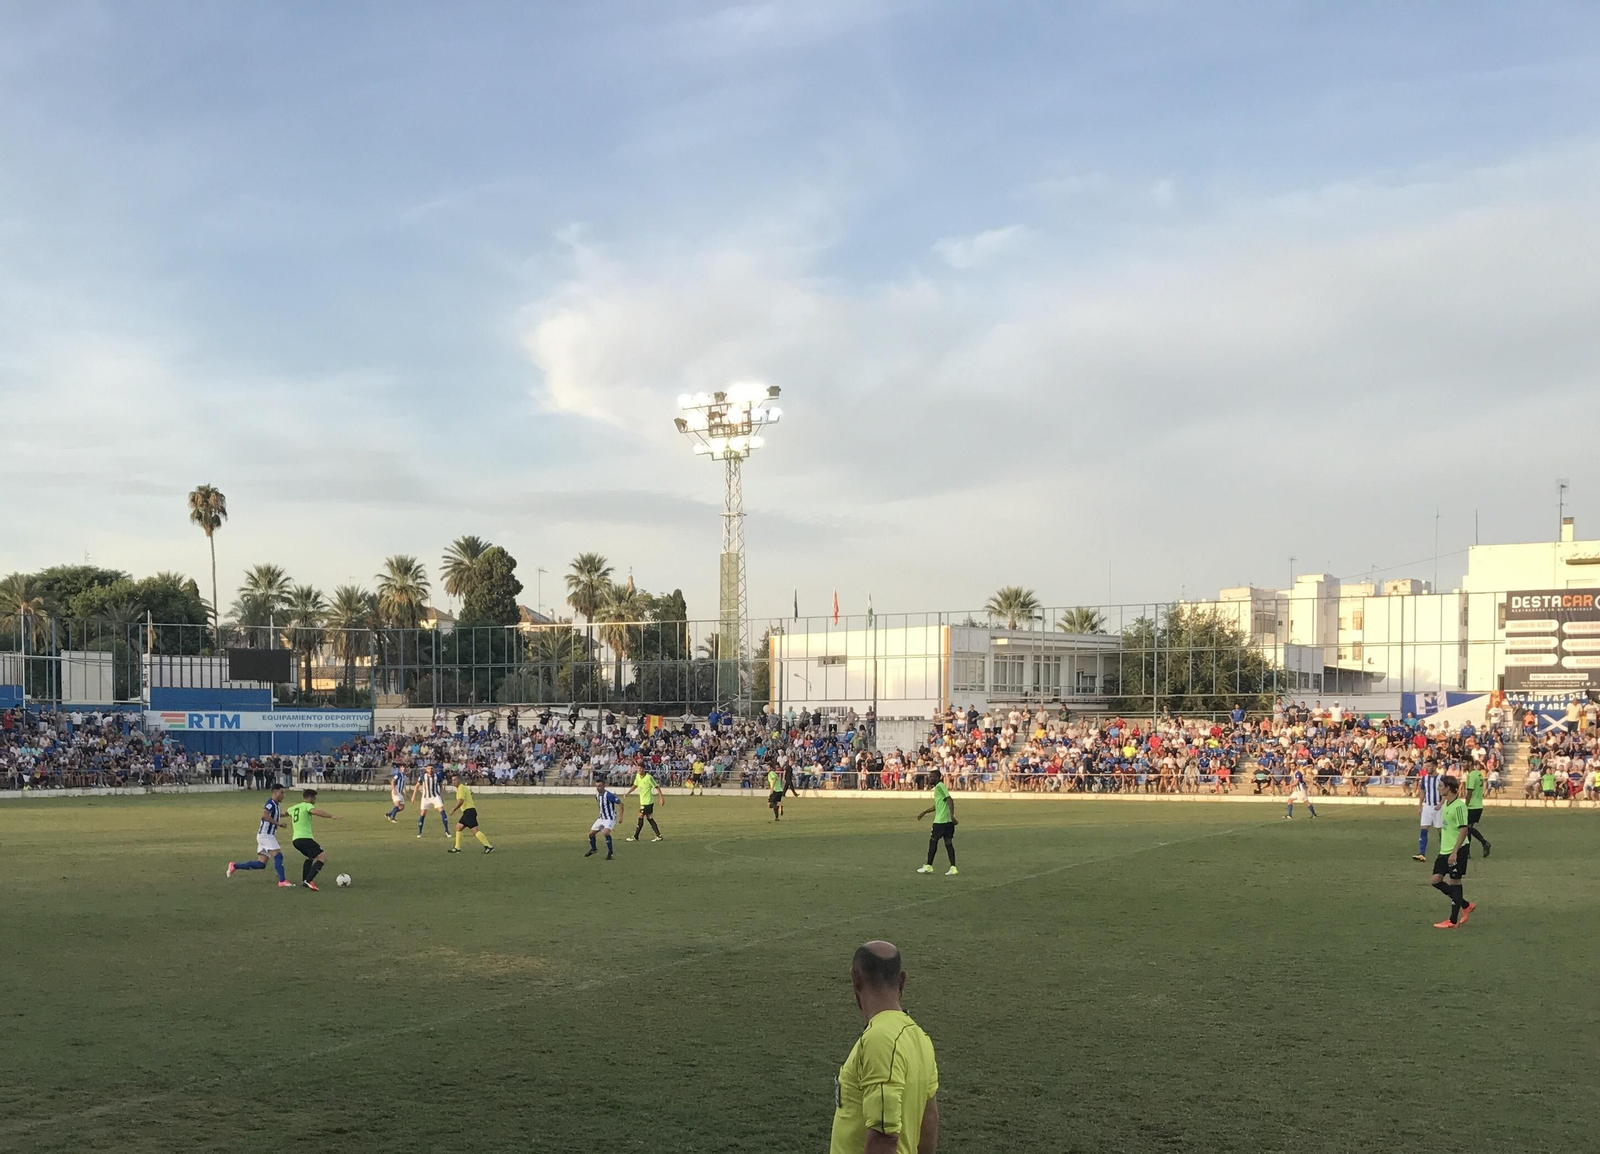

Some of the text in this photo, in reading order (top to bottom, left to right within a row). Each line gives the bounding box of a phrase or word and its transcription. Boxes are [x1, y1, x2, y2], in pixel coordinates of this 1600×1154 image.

[1511, 594, 1593, 609] DESTACAR
[1506, 692, 1525, 701] LAS
[1568, 692, 1588, 701] DEL
[1539, 702, 1567, 710] PABL
[188, 713, 240, 729] RTM
[294, 808, 300, 824] 8
